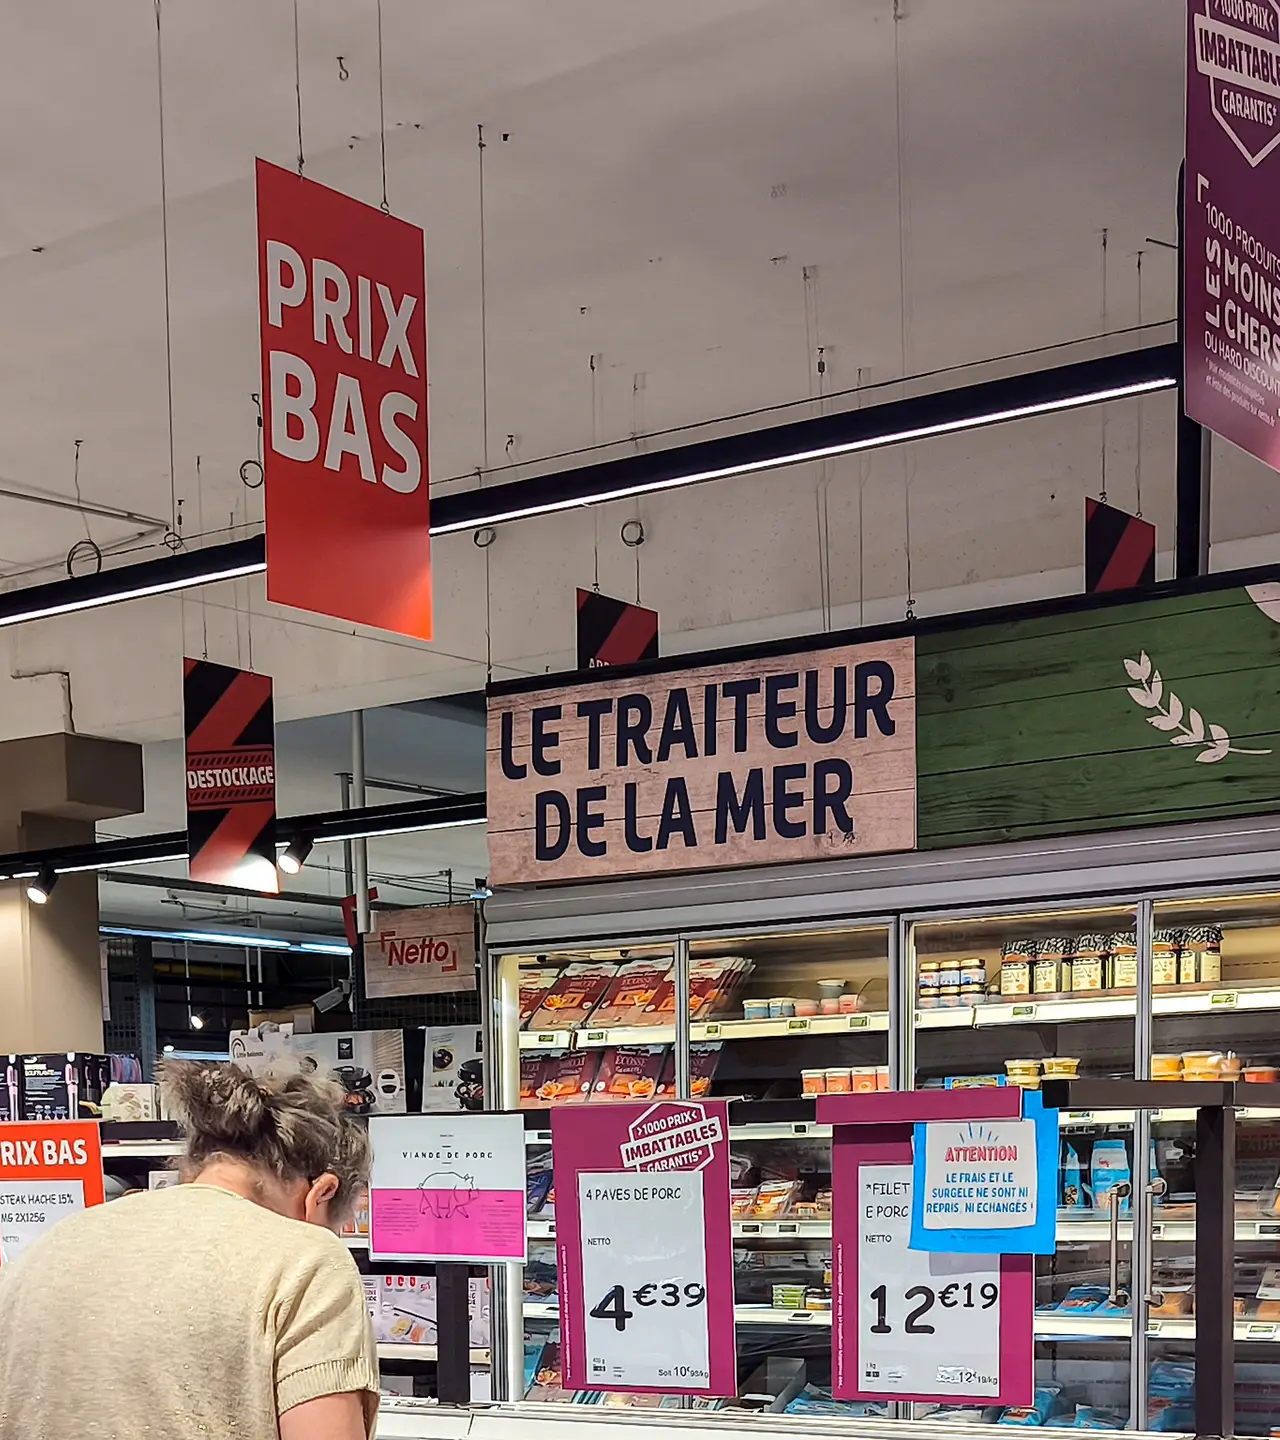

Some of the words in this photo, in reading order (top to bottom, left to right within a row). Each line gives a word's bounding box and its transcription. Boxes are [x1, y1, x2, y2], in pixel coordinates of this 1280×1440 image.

[1205, 202, 1233, 242] 1000
[1205, 236, 1220, 328] LES
[266, 239, 419, 378] PRIX
[1204, 330, 1217, 352] DU
[1219, 339, 1241, 371] HARD
[1243, 356, 1280, 397] DISCOUNT
[270, 350, 421, 494] BAS
[501, 705, 563, 780] LE
[576, 660, 896, 771] TRAITEUR
[187, 765, 274, 789] DESTOCKAGE
[535, 785, 608, 861] DE
[624, 776, 698, 854] LA
[714, 758, 854, 845] MER
[388, 937, 449, 967] Netto
[42, 1139, 88, 1166] BAS
[402, 1151, 441, 1159] VIANDE
[447, 1151, 460, 1159] DE
[625, 1122, 718, 1163] IMBATTABLES
[945, 1145, 1018, 1163] ATTENTION
[946, 1173, 957, 1183] LE
[960, 1172, 986, 1183] FRAIS
[989, 1172, 999, 1183] ET
[1003, 1172, 1014, 1182] LE
[0, 1195, 27, 1205] STEAK
[28, 1194, 57, 1205] HACHE
[58, 1194, 74, 1204] 15%
[586, 1189, 593, 1201] 4
[595, 1188, 630, 1201] PAVES
[633, 1188, 649, 1201] DE
[651, 1187, 681, 1200] PORC
[976, 1188, 988, 1198] NE
[991, 1187, 1016, 1197] SONT
[1019, 1187, 1028, 1197] NI
[866, 1206, 873, 1219] E
[876, 1205, 908, 1219] PORC
[965, 1203, 975, 1213] NI
[587, 1237, 611, 1246] NETTO
[865, 1235, 892, 1243] NETTO
[589, 1283, 706, 1331] 4€39
[869, 1282, 999, 1335] 12€19
